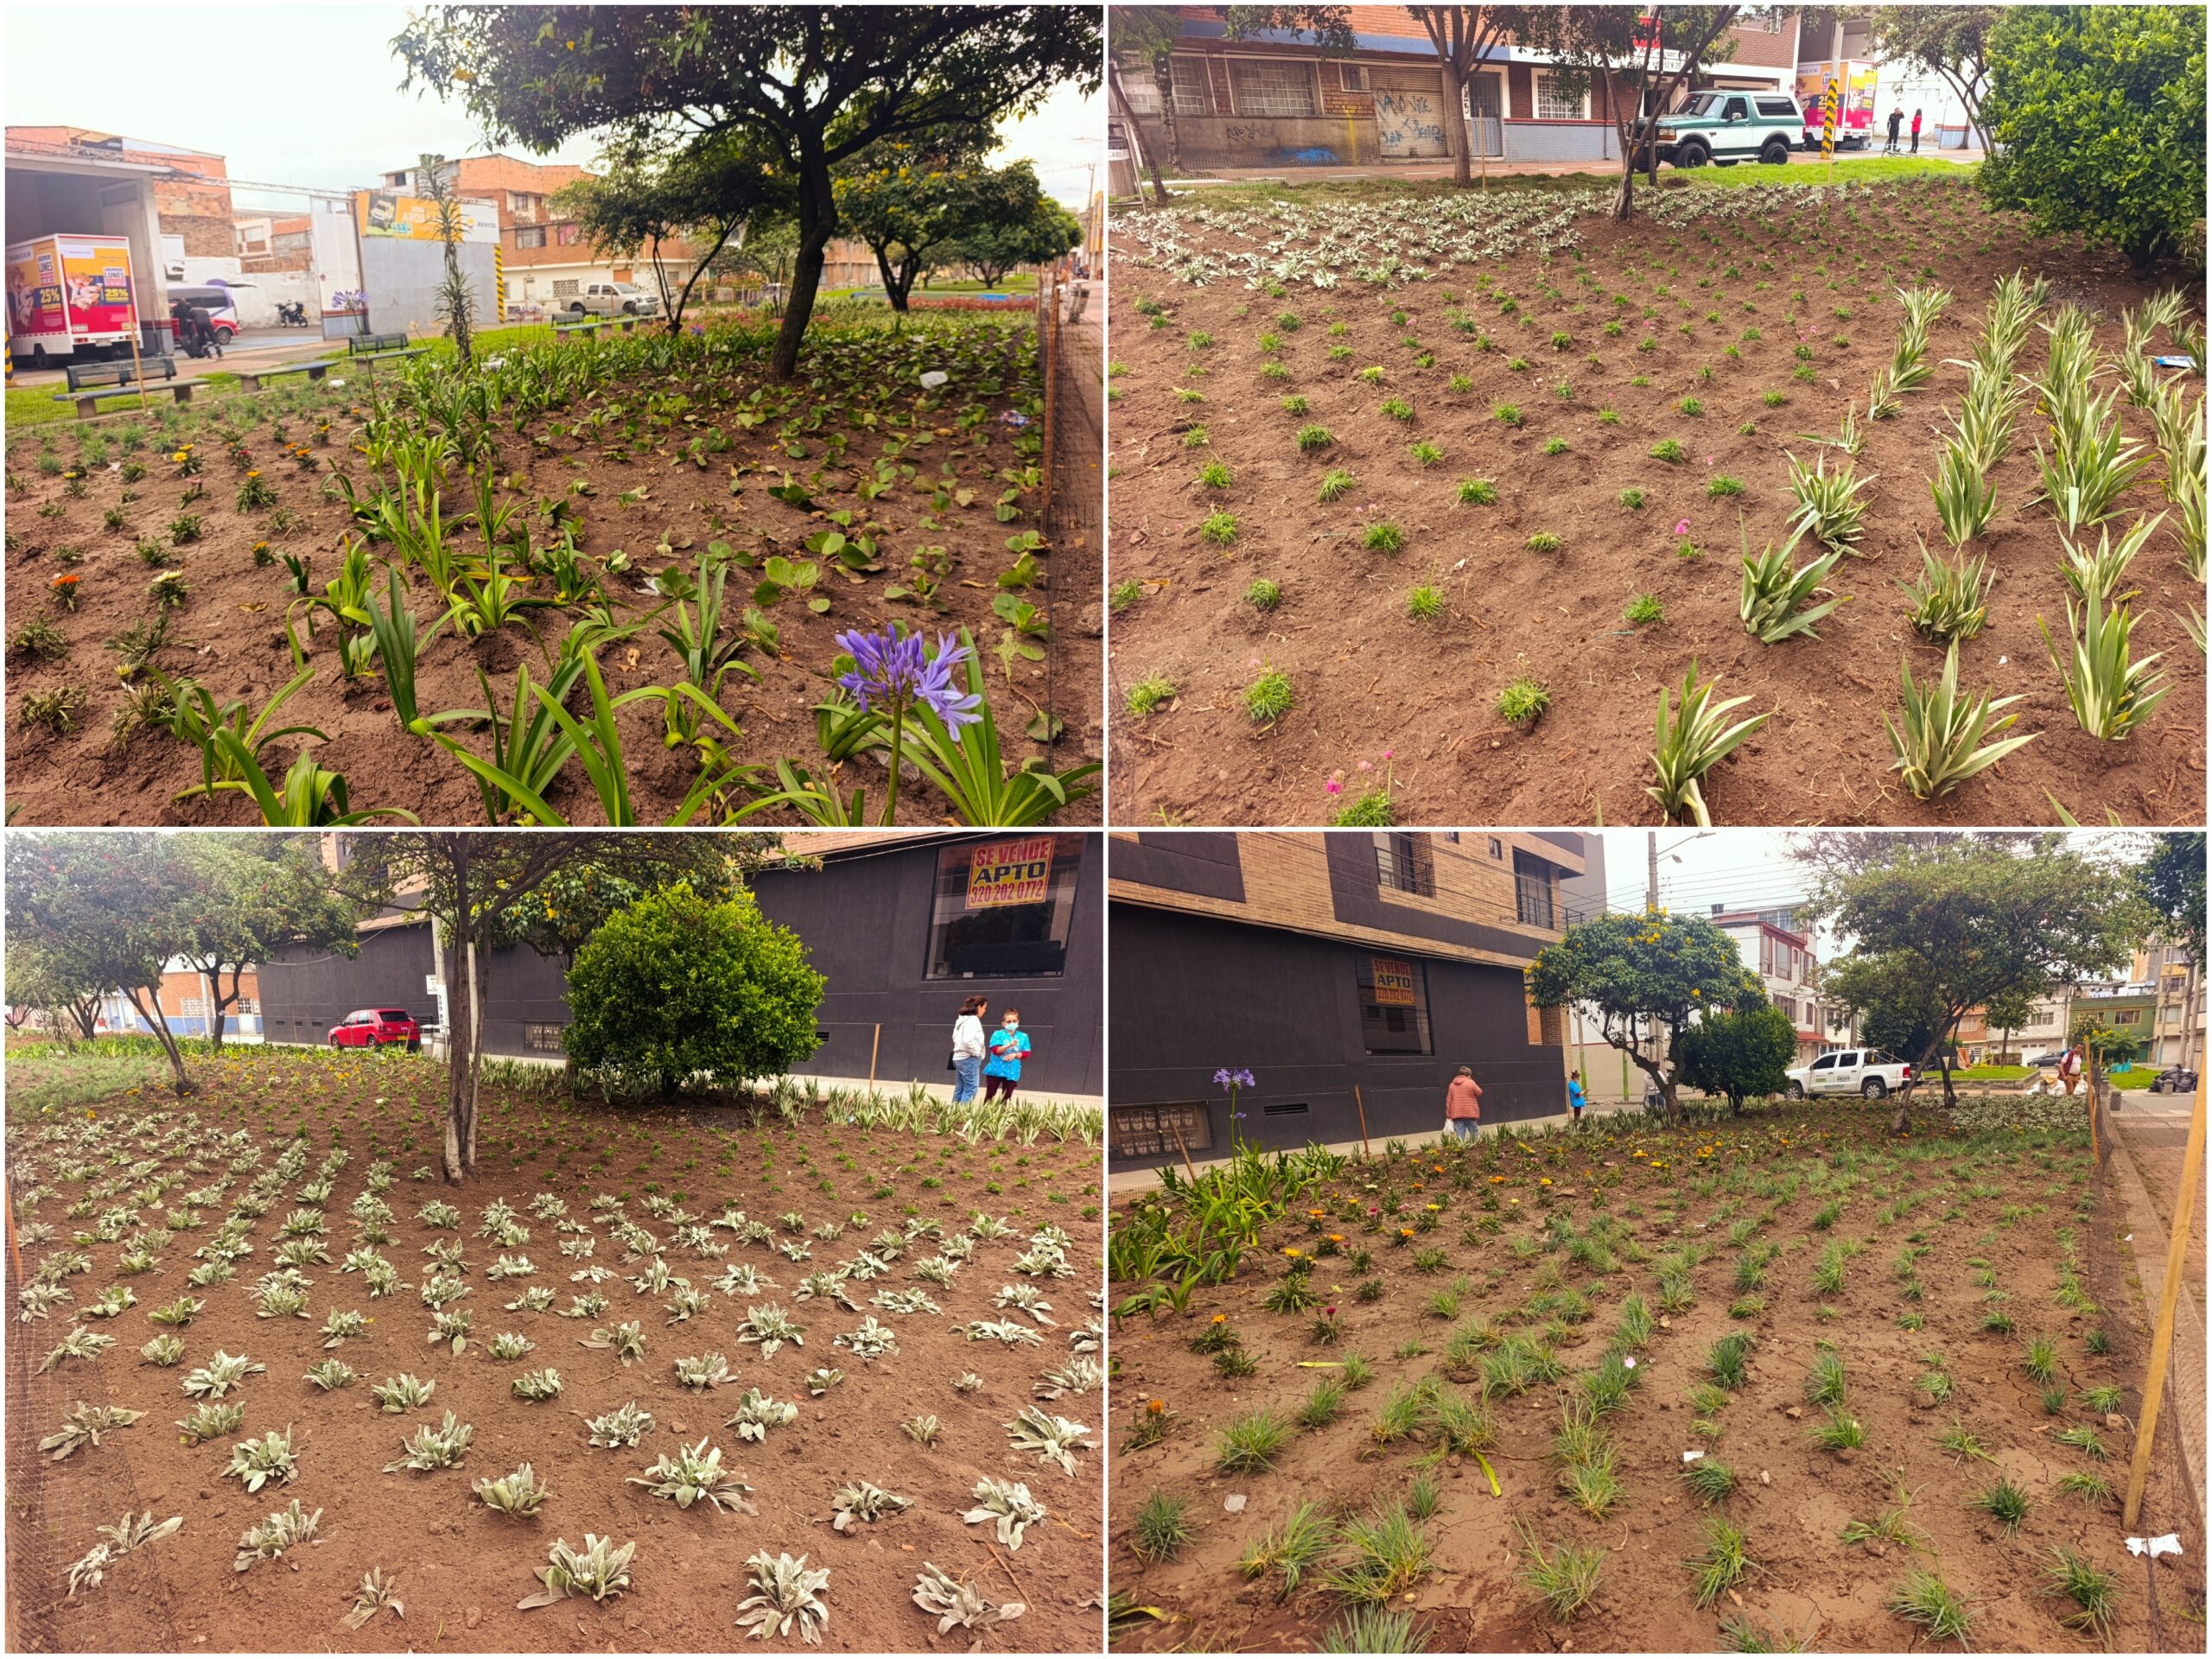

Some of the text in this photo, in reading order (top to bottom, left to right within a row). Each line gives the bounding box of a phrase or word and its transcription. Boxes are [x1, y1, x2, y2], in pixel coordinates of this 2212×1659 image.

[40, 288, 60, 303] 25%
[105, 289, 129, 297] 25%
[976, 841, 1049, 867] SE VENDE
[974, 861, 1047, 885] APTO
[970, 880, 1045, 904] 320 202 0772
[1375, 960, 1409, 976] SE VENDE
[1377, 975, 1410, 988] APTO
